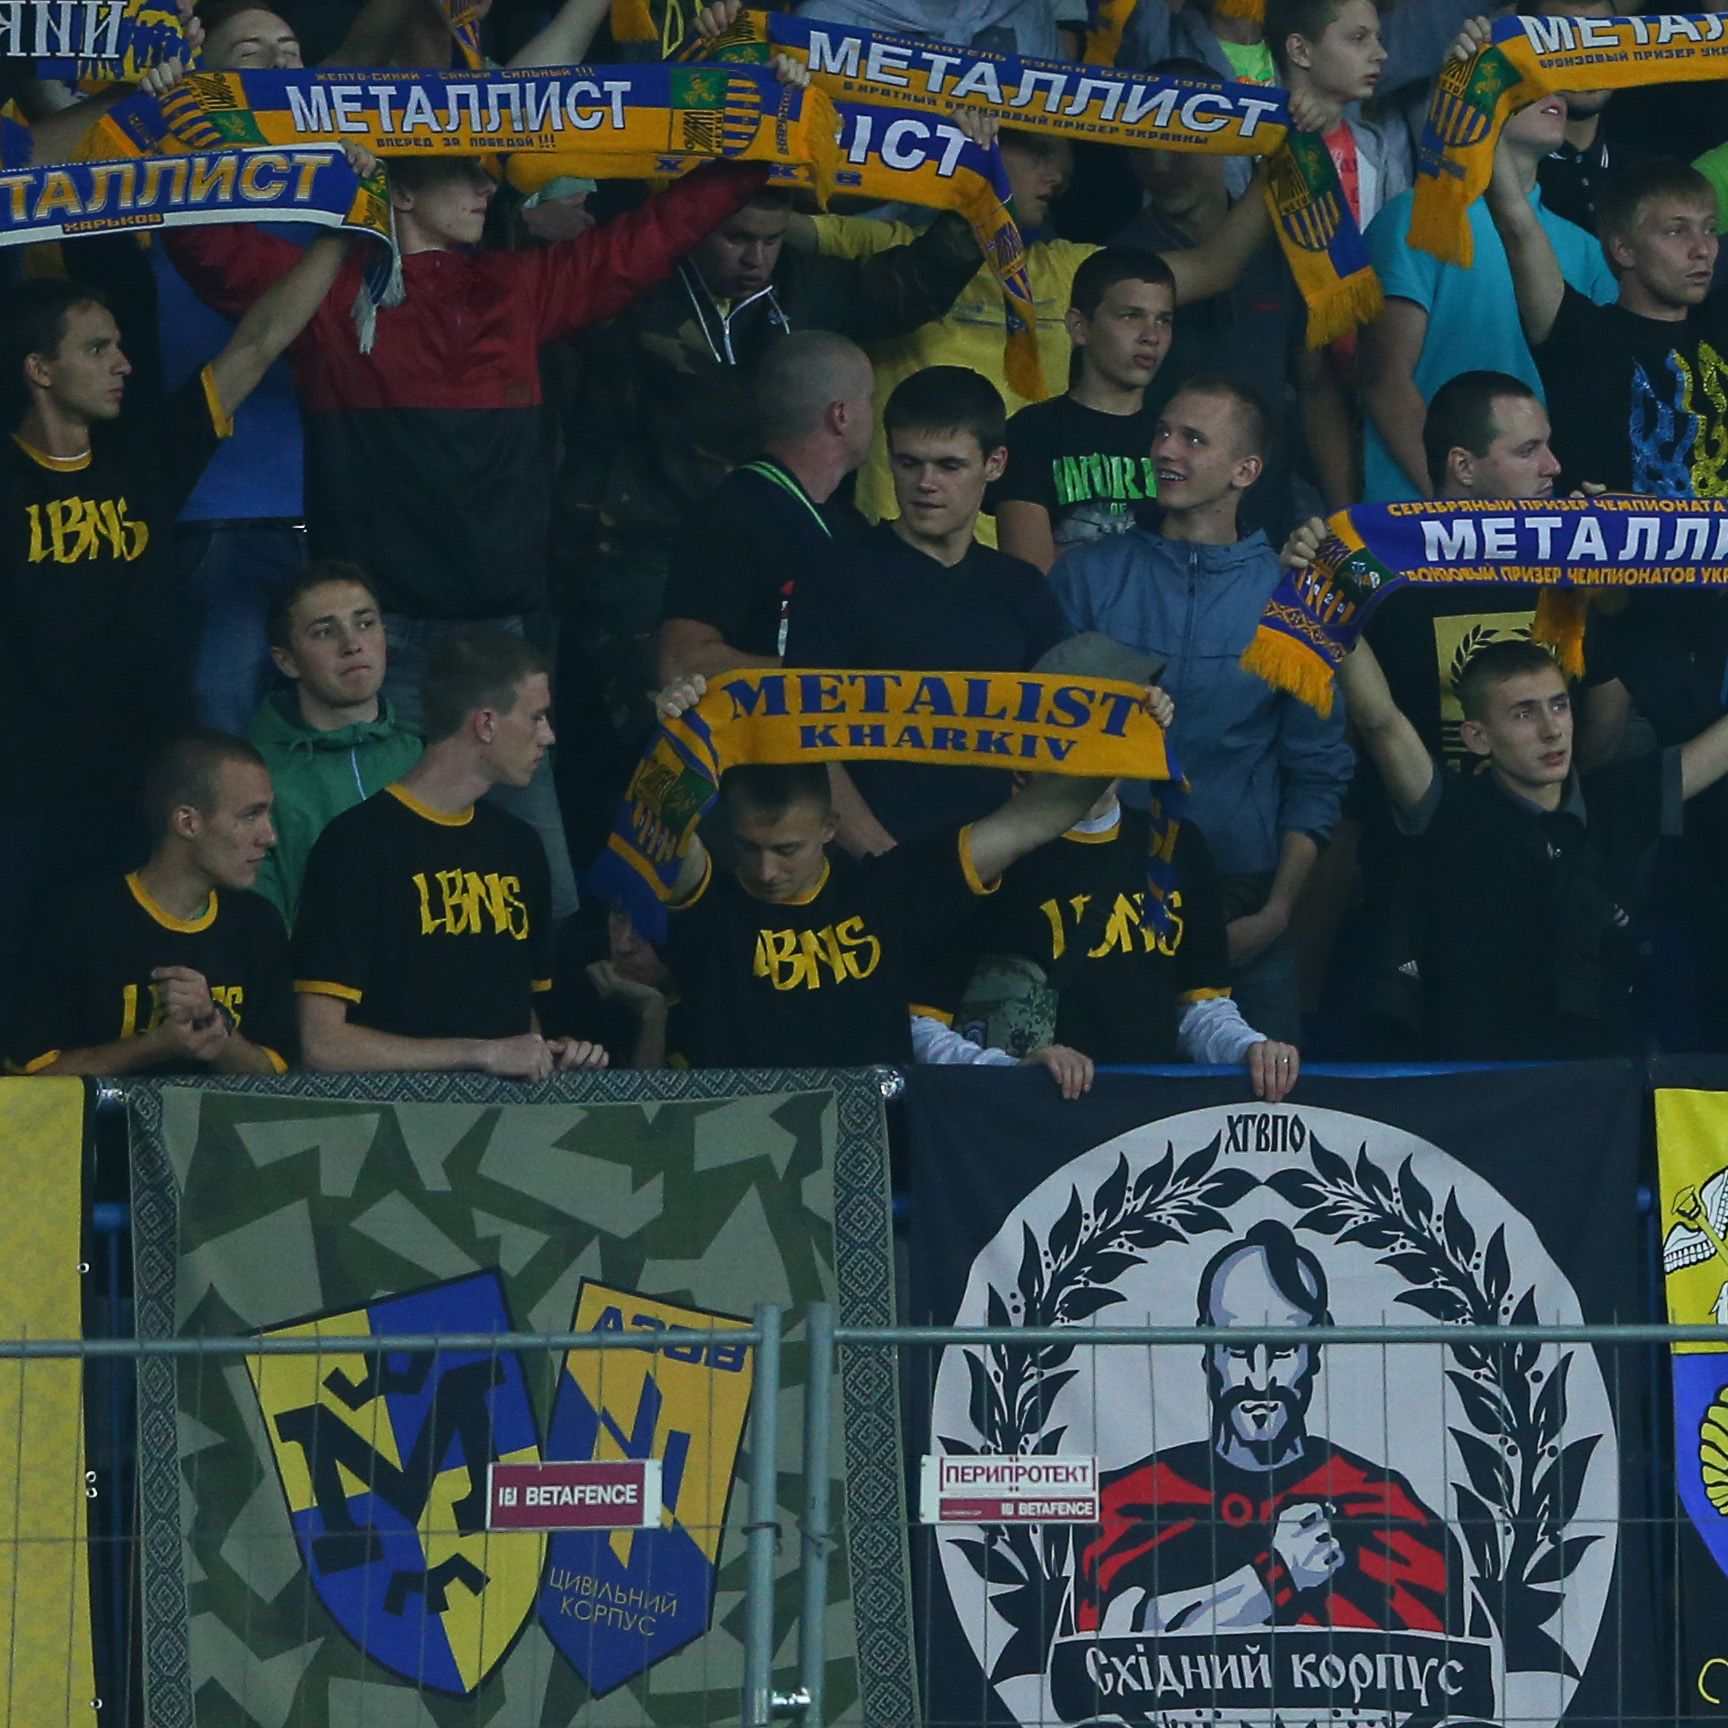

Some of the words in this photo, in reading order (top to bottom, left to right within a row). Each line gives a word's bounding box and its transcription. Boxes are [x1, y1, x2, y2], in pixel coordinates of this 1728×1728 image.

[1633, 48, 1696, 63] ПРИЗЕР
[806, 31, 1279, 136] МЕТАЛЛИСТ
[286, 78, 632, 134] МЕТАЛЛИСТ
[376, 138, 434, 150] ВПЕРЕД
[443, 138, 462, 150] ЗА
[470, 137, 533, 150] ПОБЕДОЙ
[64, 212, 162, 234] ХАРЬКОВ
[1520, 500, 1589, 514] ПРИЗЕР
[1501, 567, 1562, 583] ПРИЗЕР
[1566, 567, 1697, 586] ЧЕМПИОНАТОВ
[721, 673, 1146, 738] METALIST
[799, 723, 1078, 762] KHARKIV
[945, 1463, 1091, 1485] ПЕРИПРОТЕКТ
[526, 1485, 639, 1508] BETAFENCE
[1018, 1499, 1095, 1516] BETAFENCE
[549, 1565, 678, 1618] ЦИВІЛЬНИЙ
[559, 1600, 658, 1638] КОРПУС
[1084, 1643, 1275, 1699] Східний
[1291, 1651, 1464, 1706] корпус
